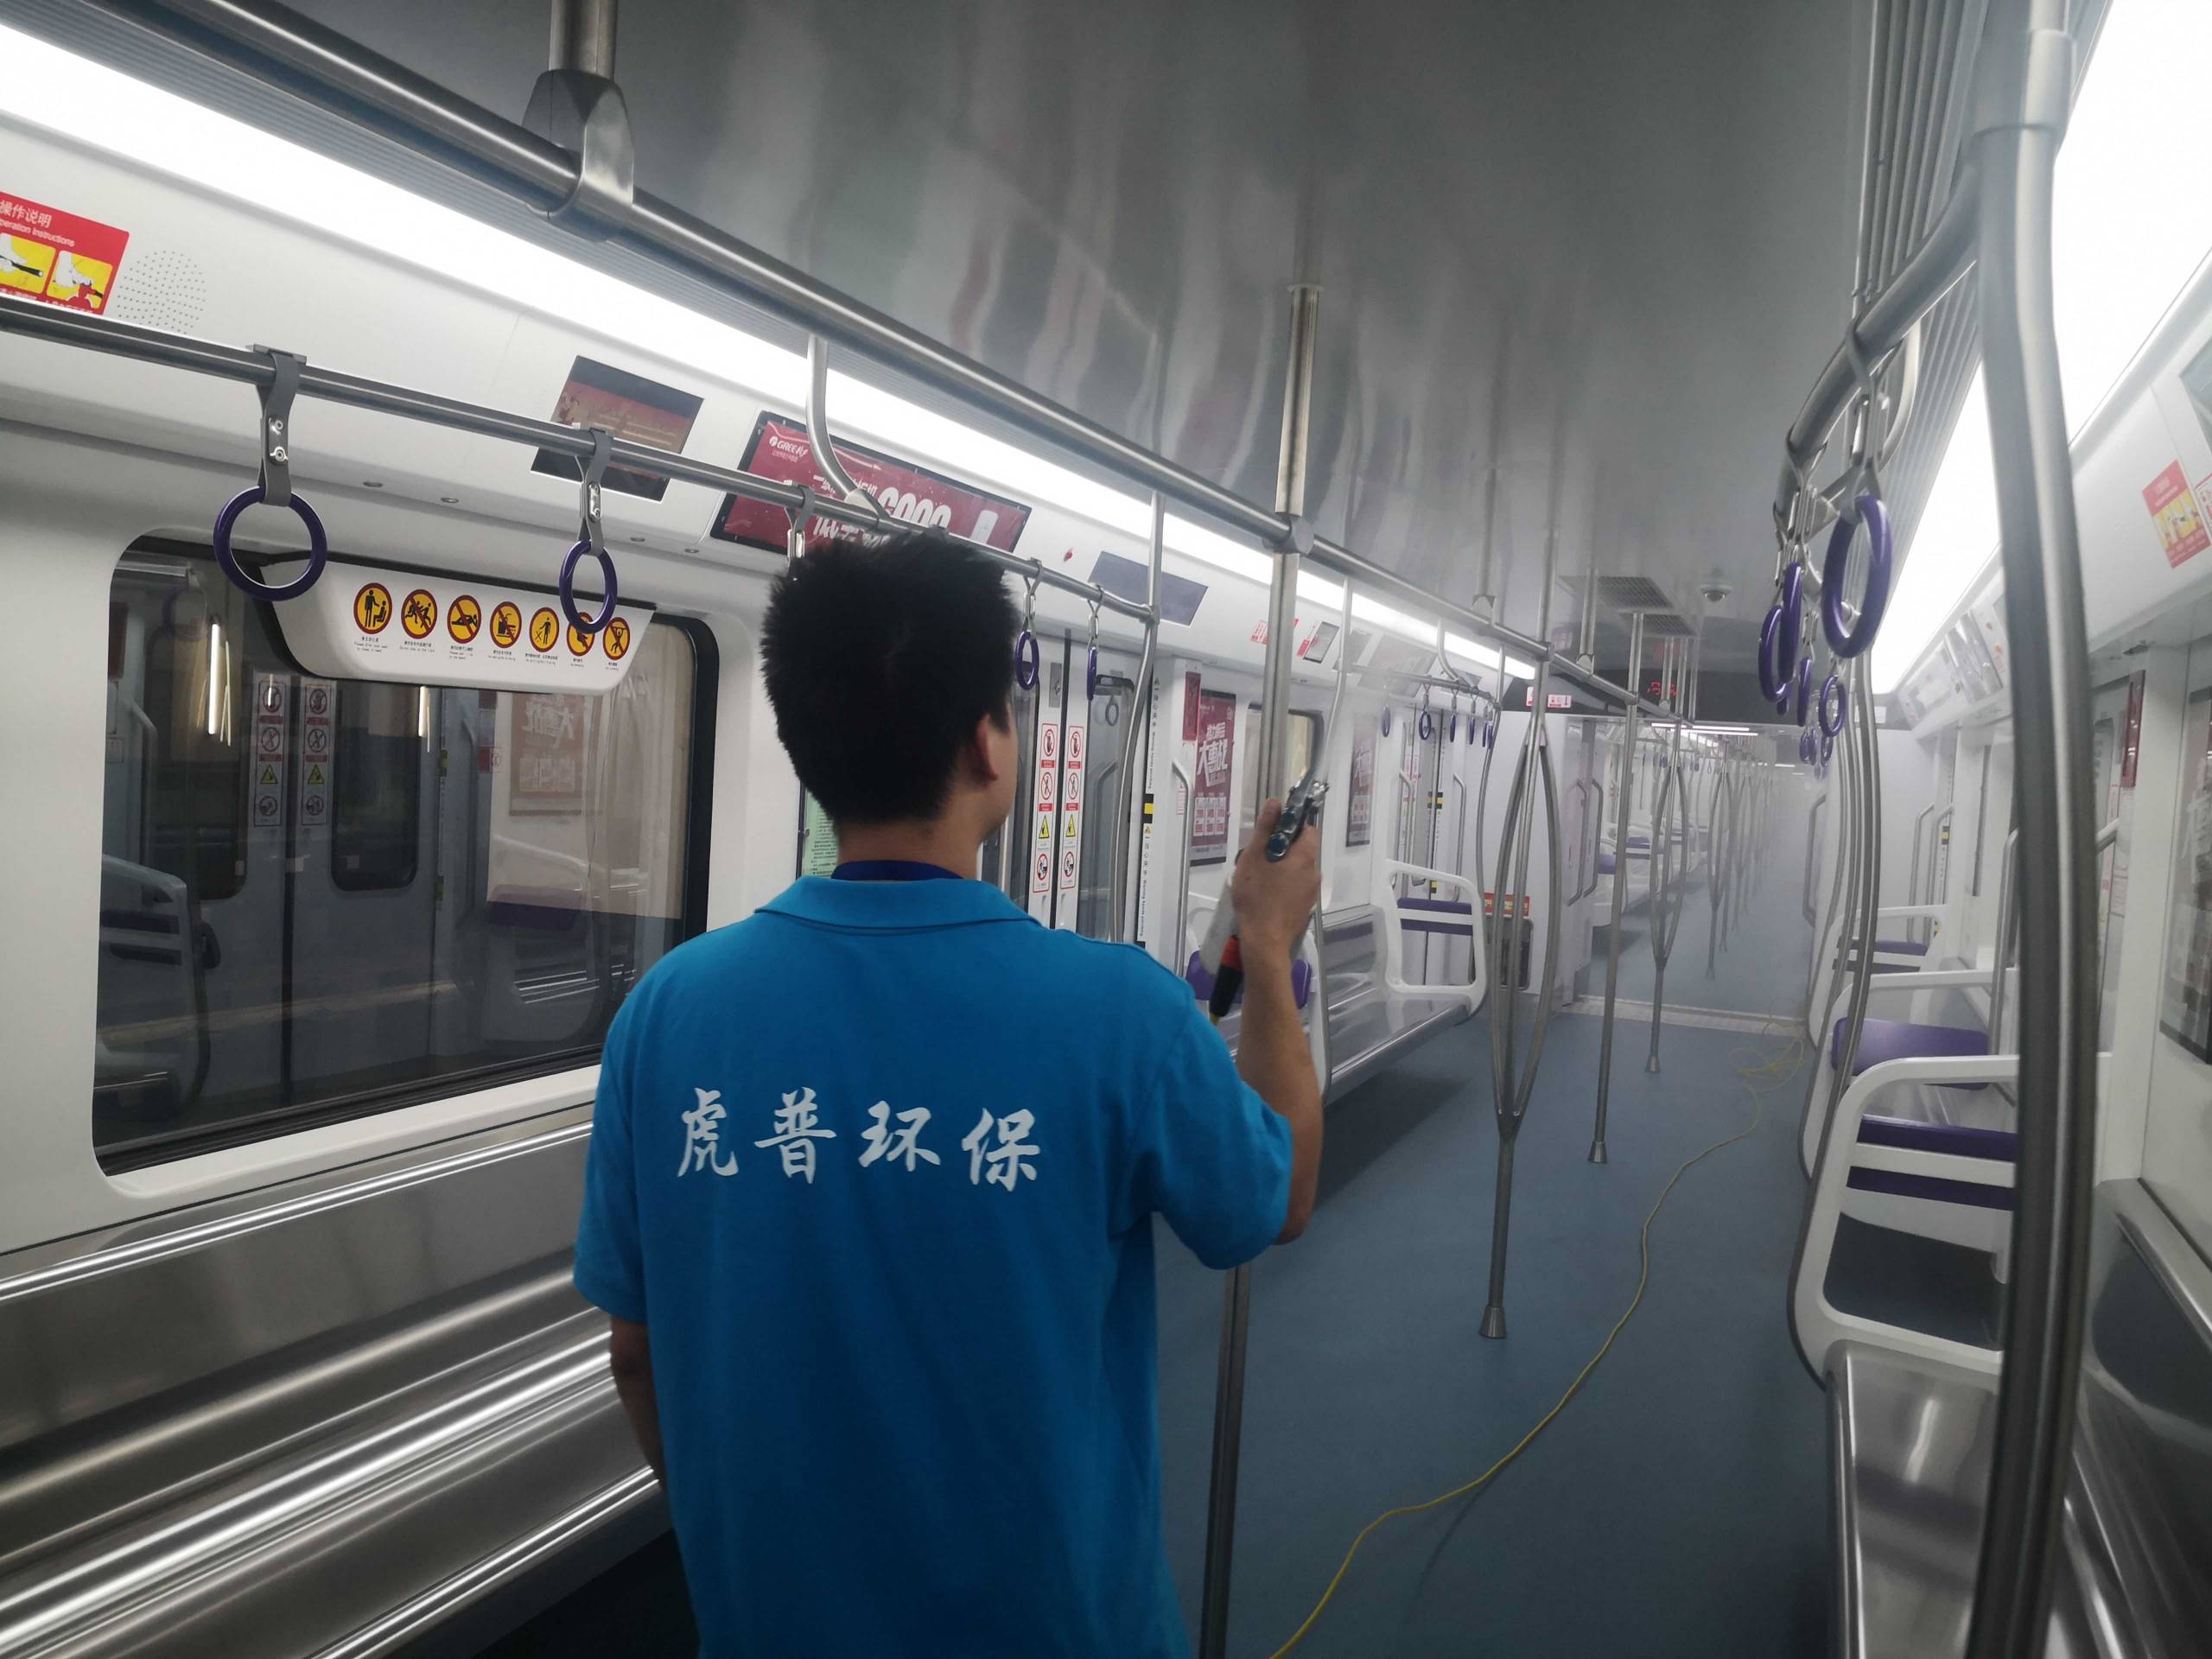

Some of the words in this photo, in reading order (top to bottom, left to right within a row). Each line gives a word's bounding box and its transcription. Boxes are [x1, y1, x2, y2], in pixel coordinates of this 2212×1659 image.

[0, 200, 52, 228] 操作说明
[0, 219, 31, 233] peration
[677, 1086, 1041, 1192] 虎普环保
